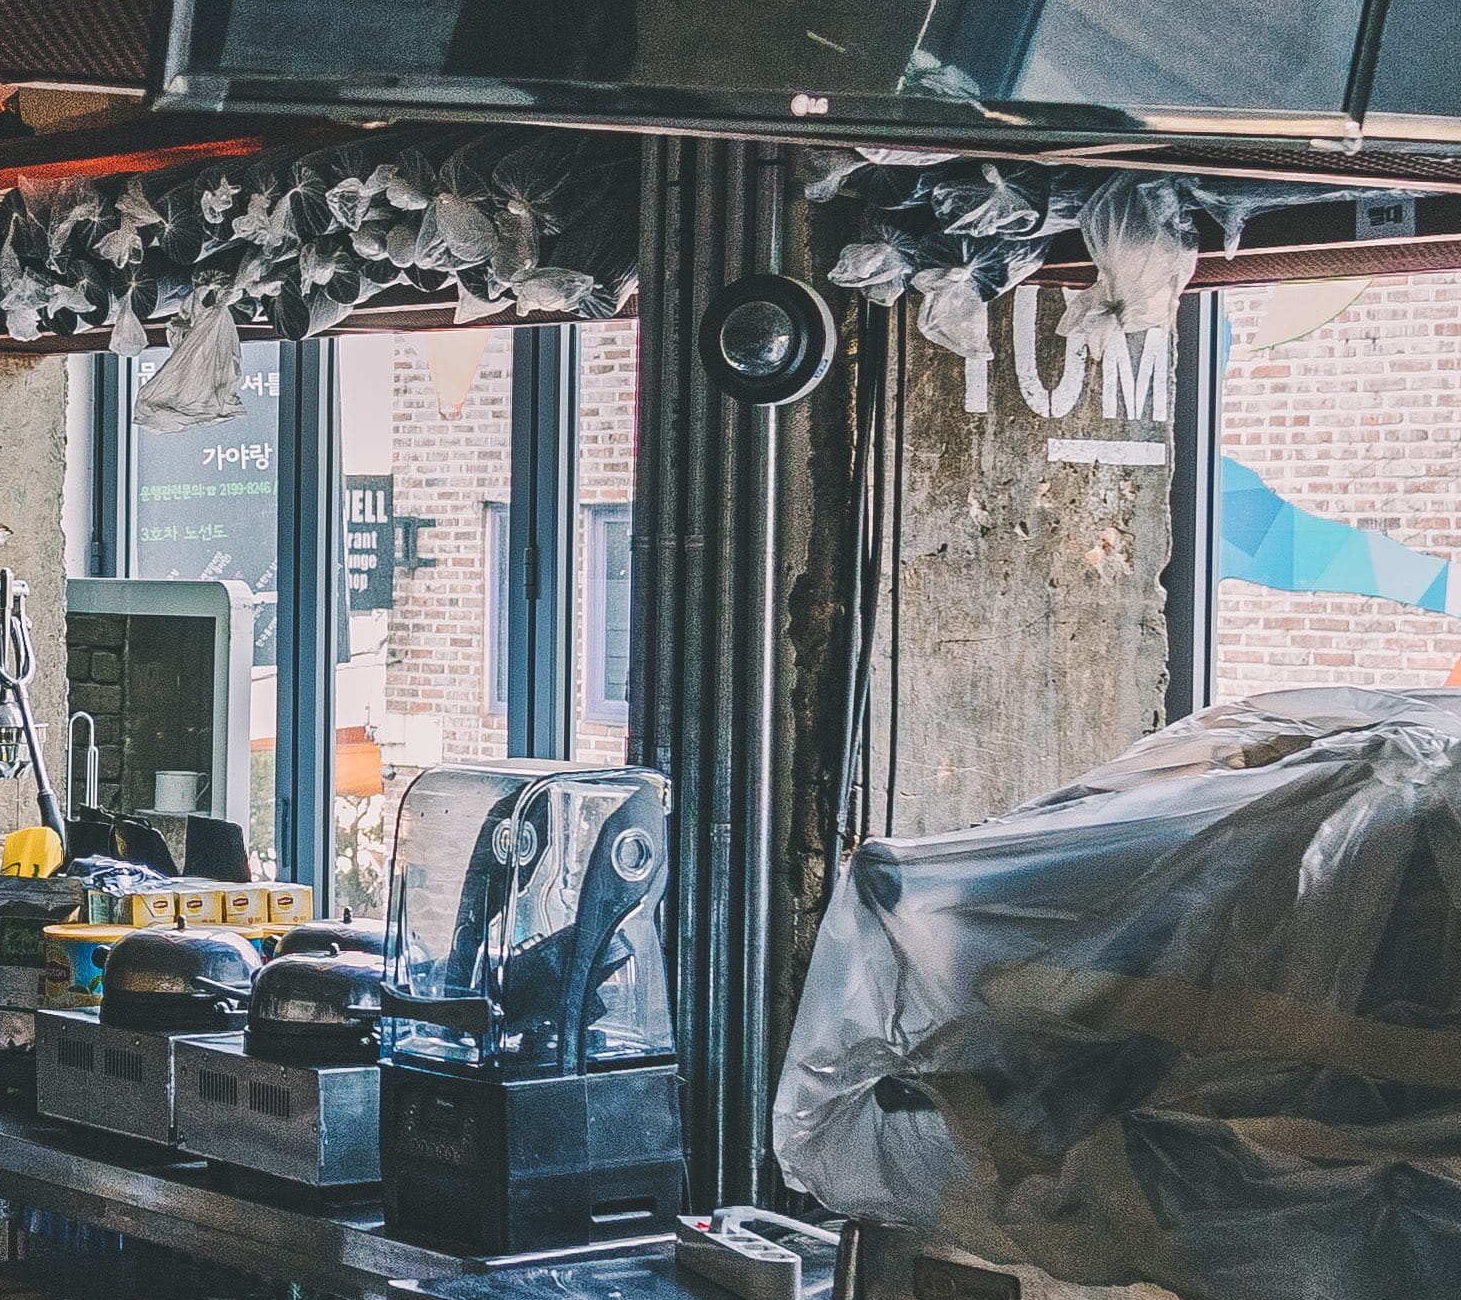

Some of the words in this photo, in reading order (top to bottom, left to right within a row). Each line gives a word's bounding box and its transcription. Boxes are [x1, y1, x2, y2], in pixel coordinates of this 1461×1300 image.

[202, 443, 273, 471] 가야랑
[220, 481, 270, 496] 2199-8246
[140, 526, 178, 542] 3호차
[184, 524, 228, 541] 노선도
